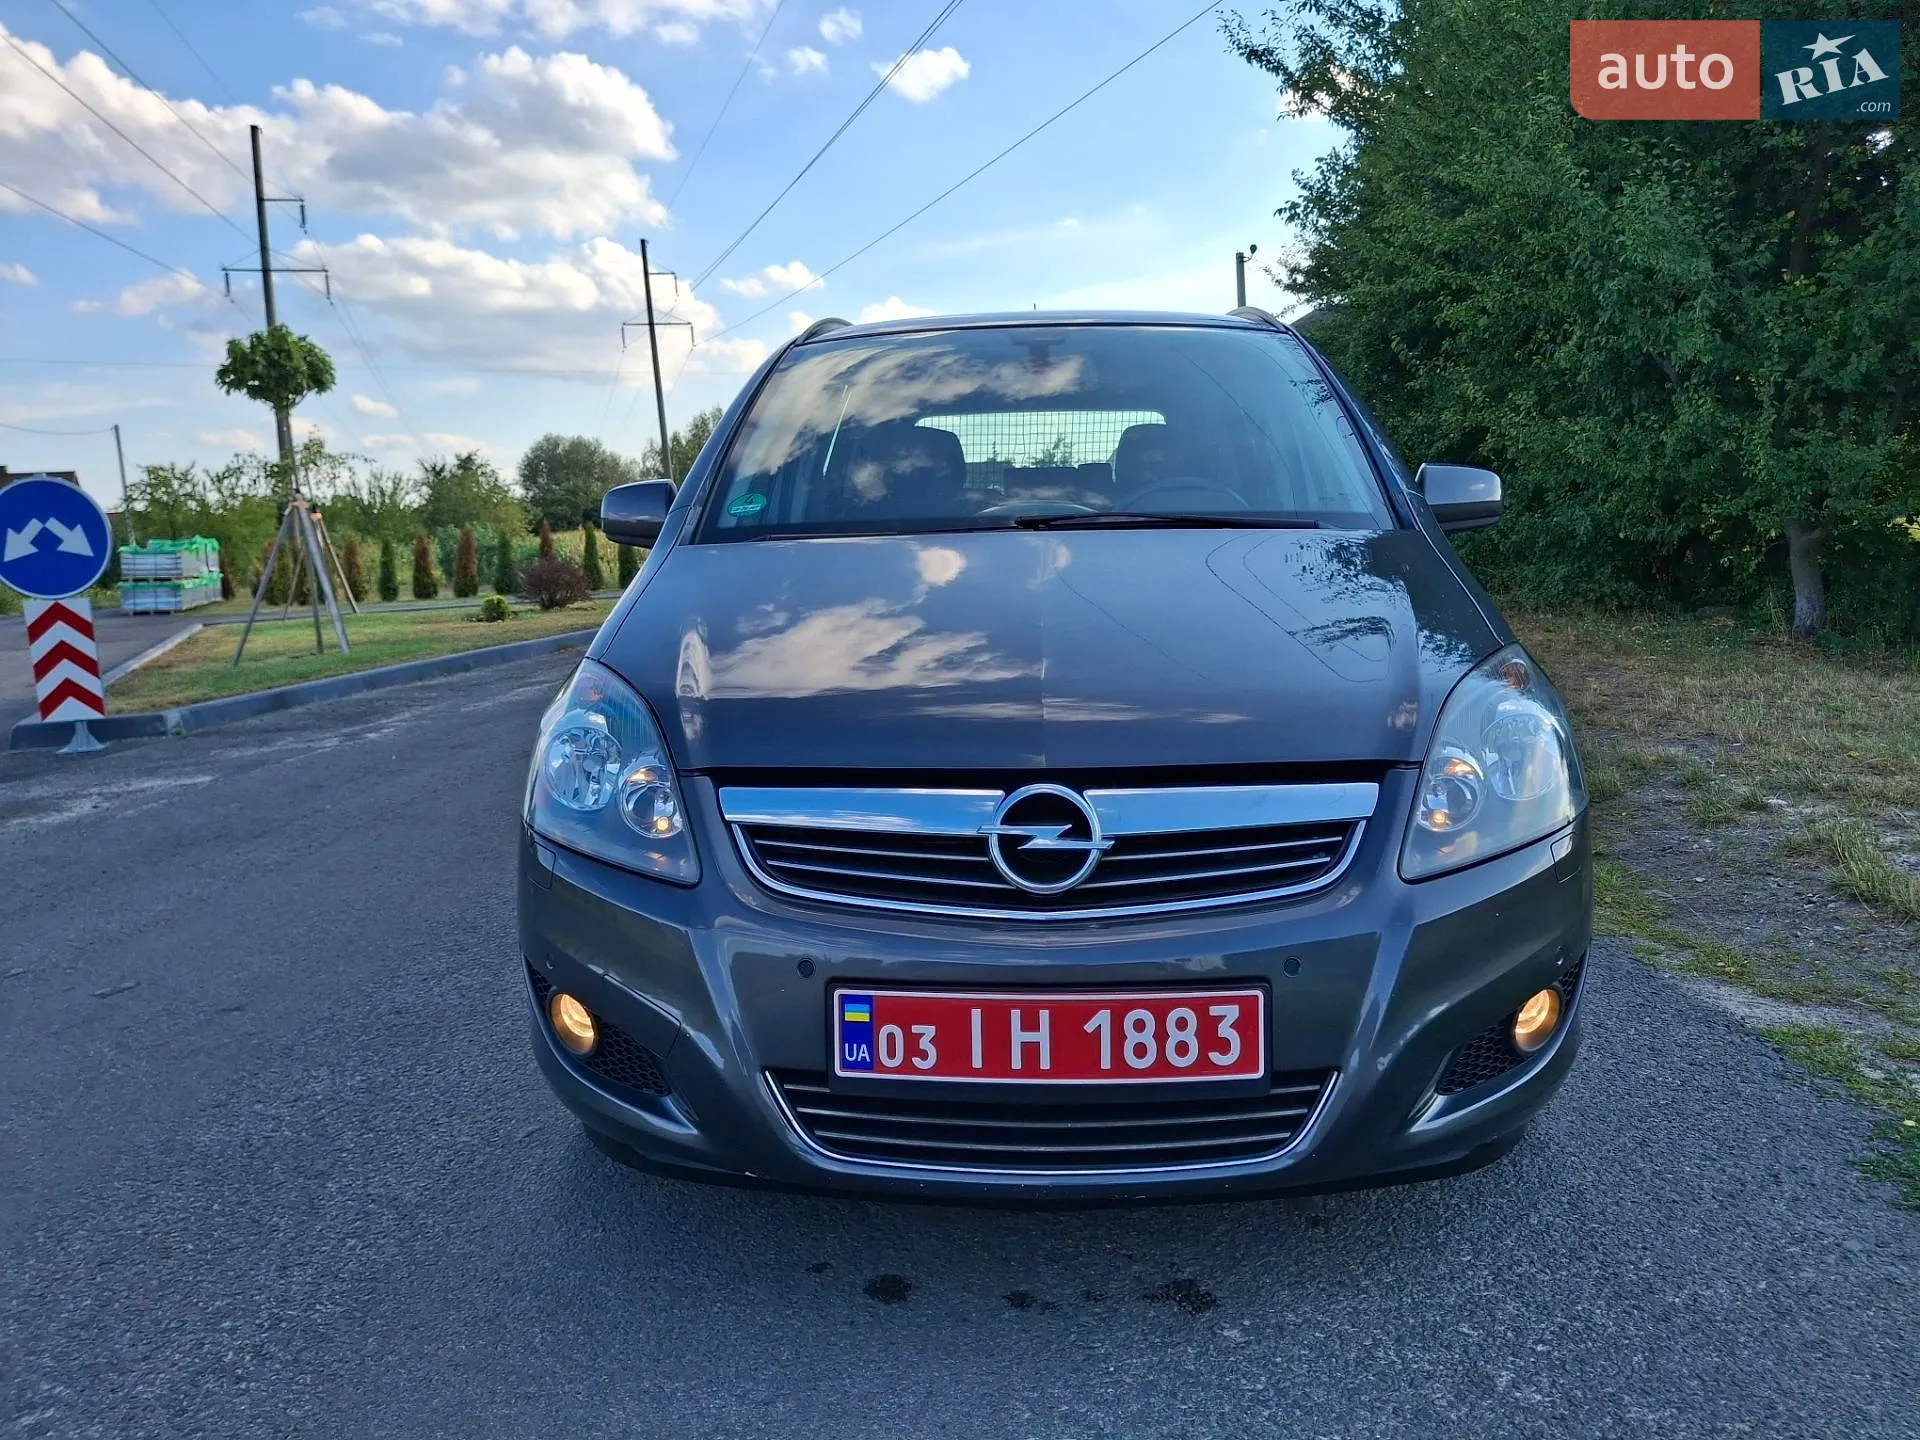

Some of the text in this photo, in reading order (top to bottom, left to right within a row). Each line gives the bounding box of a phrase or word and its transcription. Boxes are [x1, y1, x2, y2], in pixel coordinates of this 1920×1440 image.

[845, 1043, 870, 1062] UA
[879, 1005, 1241, 1070] 03 IH 1883
